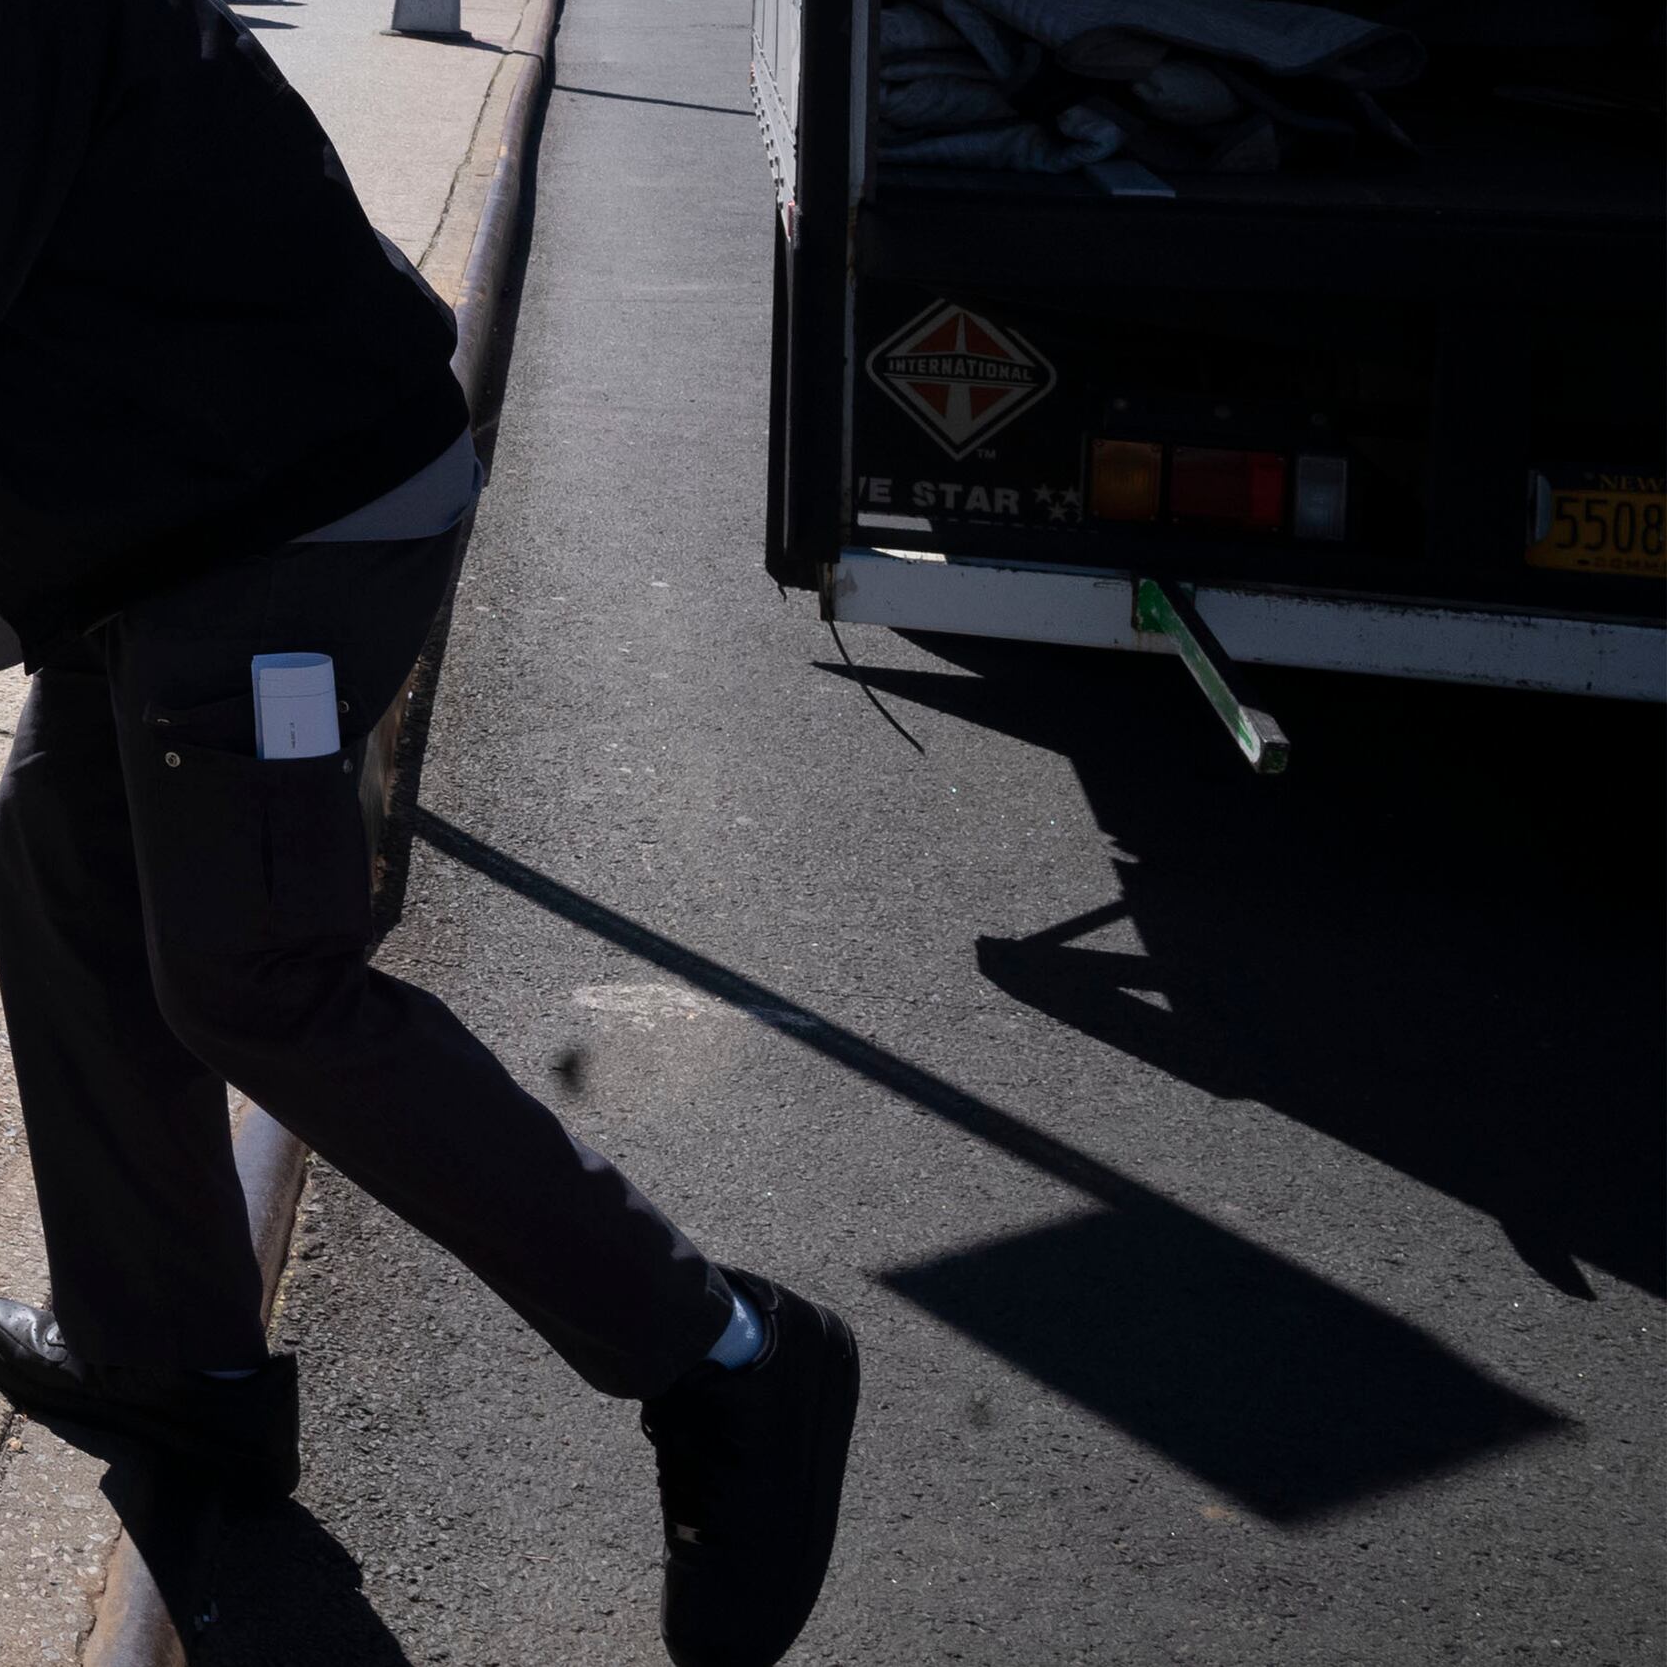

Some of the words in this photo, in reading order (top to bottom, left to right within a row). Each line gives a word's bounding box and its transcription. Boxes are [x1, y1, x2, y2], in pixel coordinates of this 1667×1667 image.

[888, 357, 1034, 382] INTERNATIONAL
[975, 448, 997, 461] TM
[911, 479, 1020, 515] STAR
